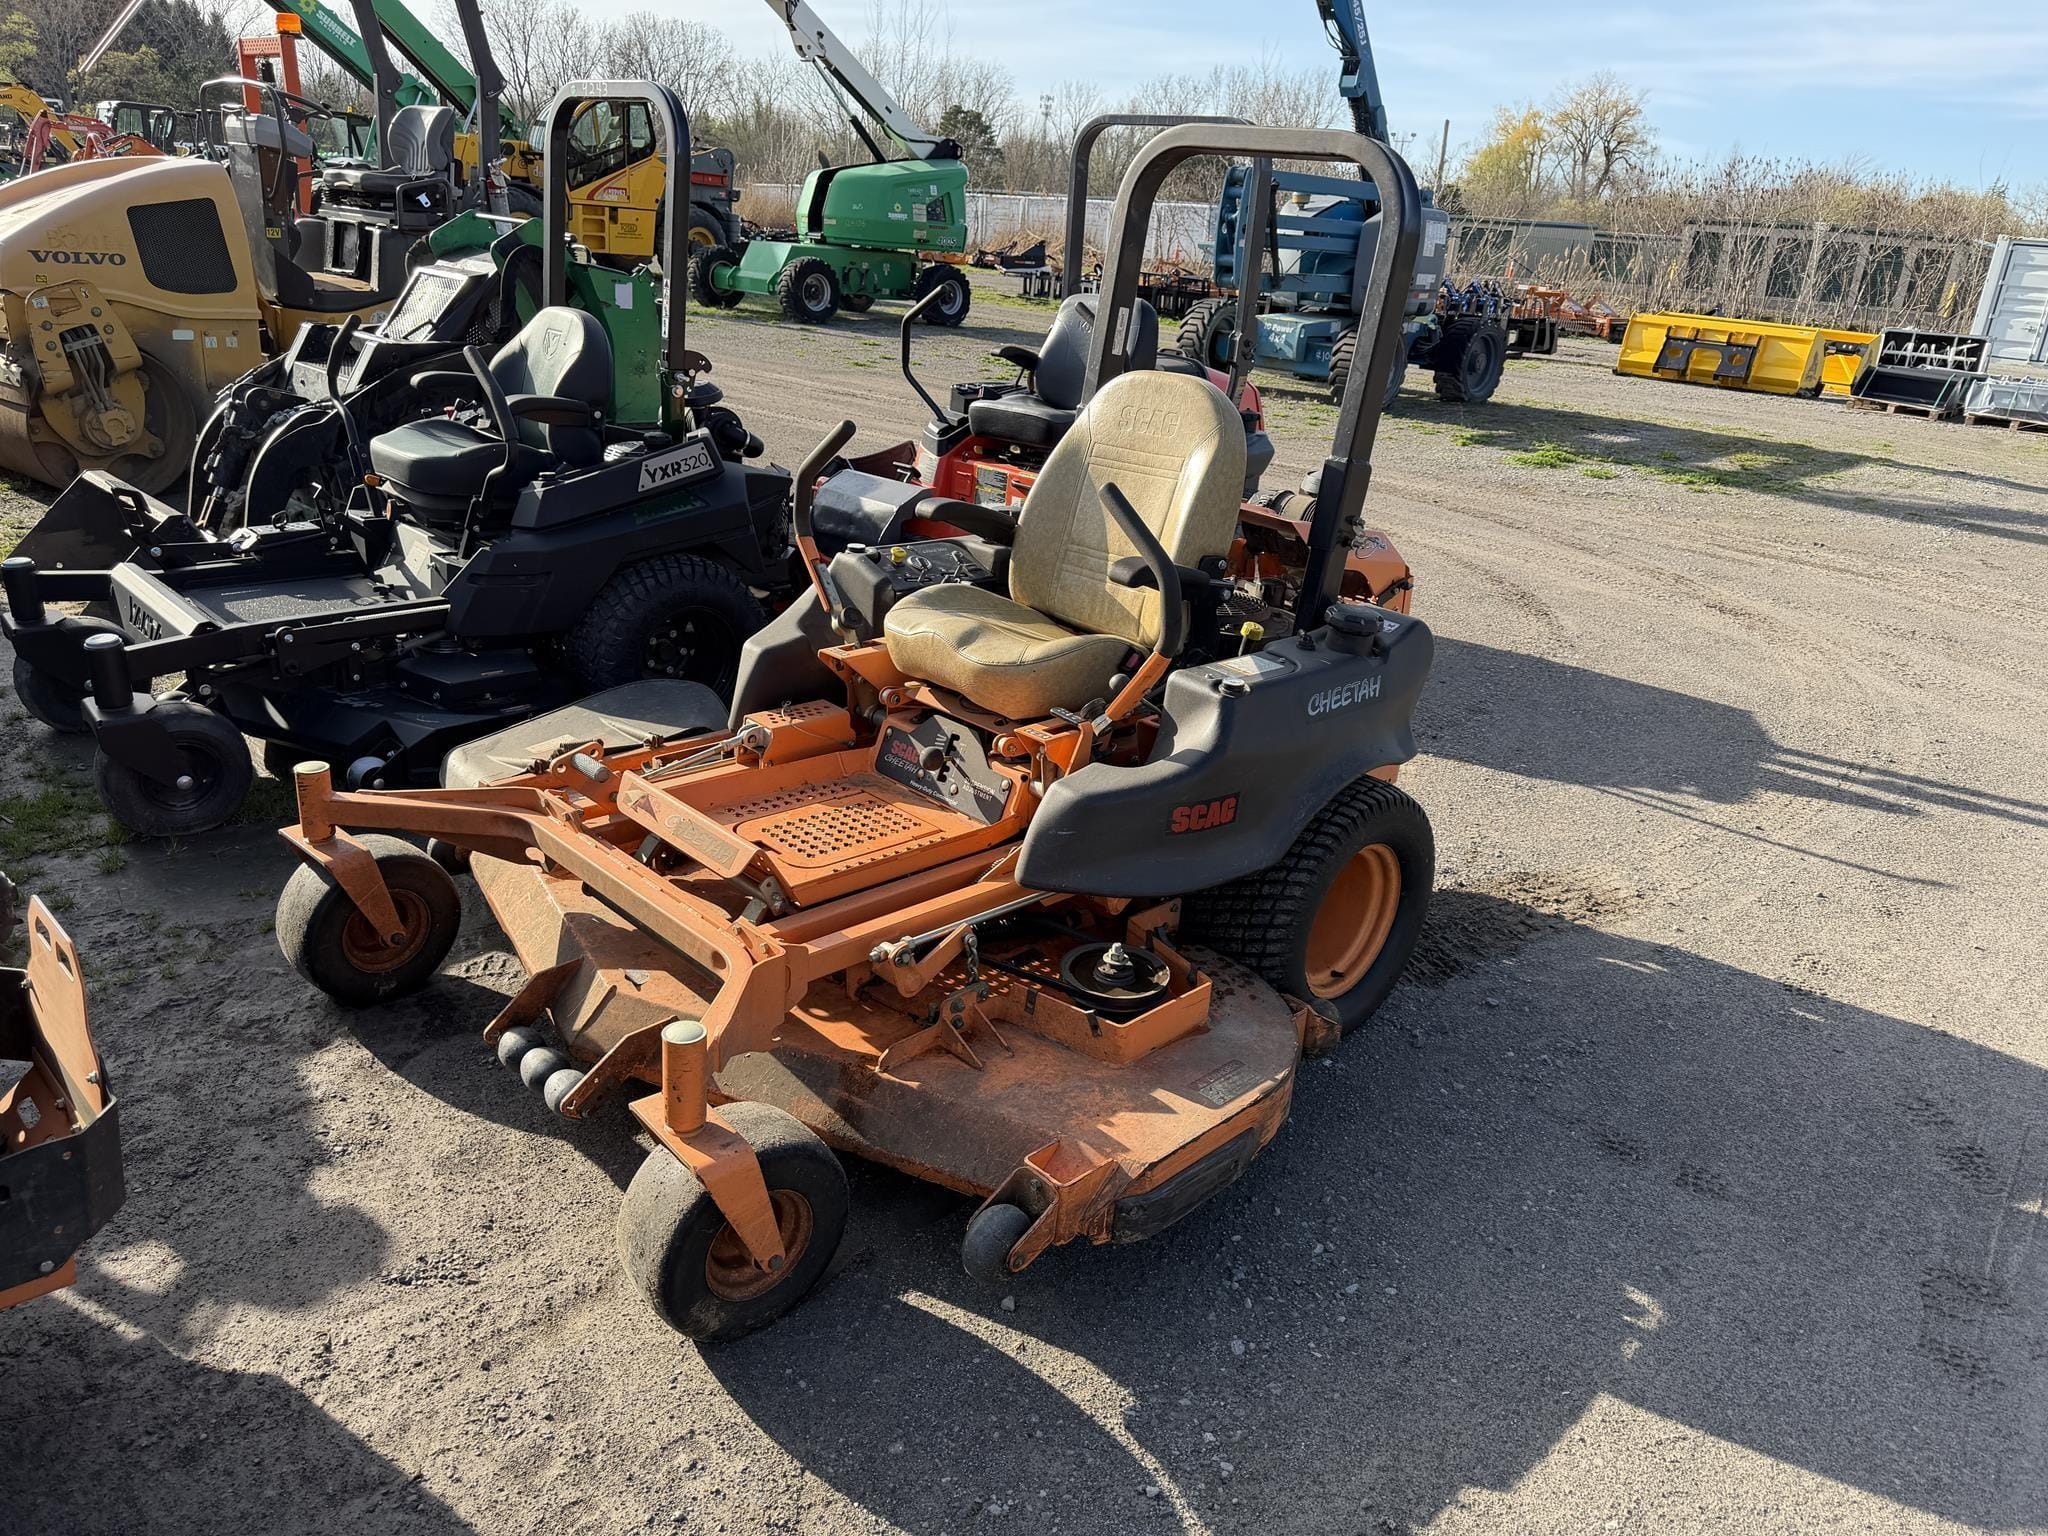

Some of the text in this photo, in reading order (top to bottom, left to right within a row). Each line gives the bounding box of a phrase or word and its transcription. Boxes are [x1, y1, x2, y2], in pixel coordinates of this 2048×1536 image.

[316, 10, 357, 48] SUNBELT
[27, 250, 126, 266] VOLVO
[1272, 322, 1294, 334] Power
[1118, 405, 1181, 438] SCAG
[644, 452, 709, 484] YXR320
[1307, 674, 1382, 716] CHEETAH
[884, 753, 920, 774] CHEETAH
[1171, 797, 1237, 833] SCAG
